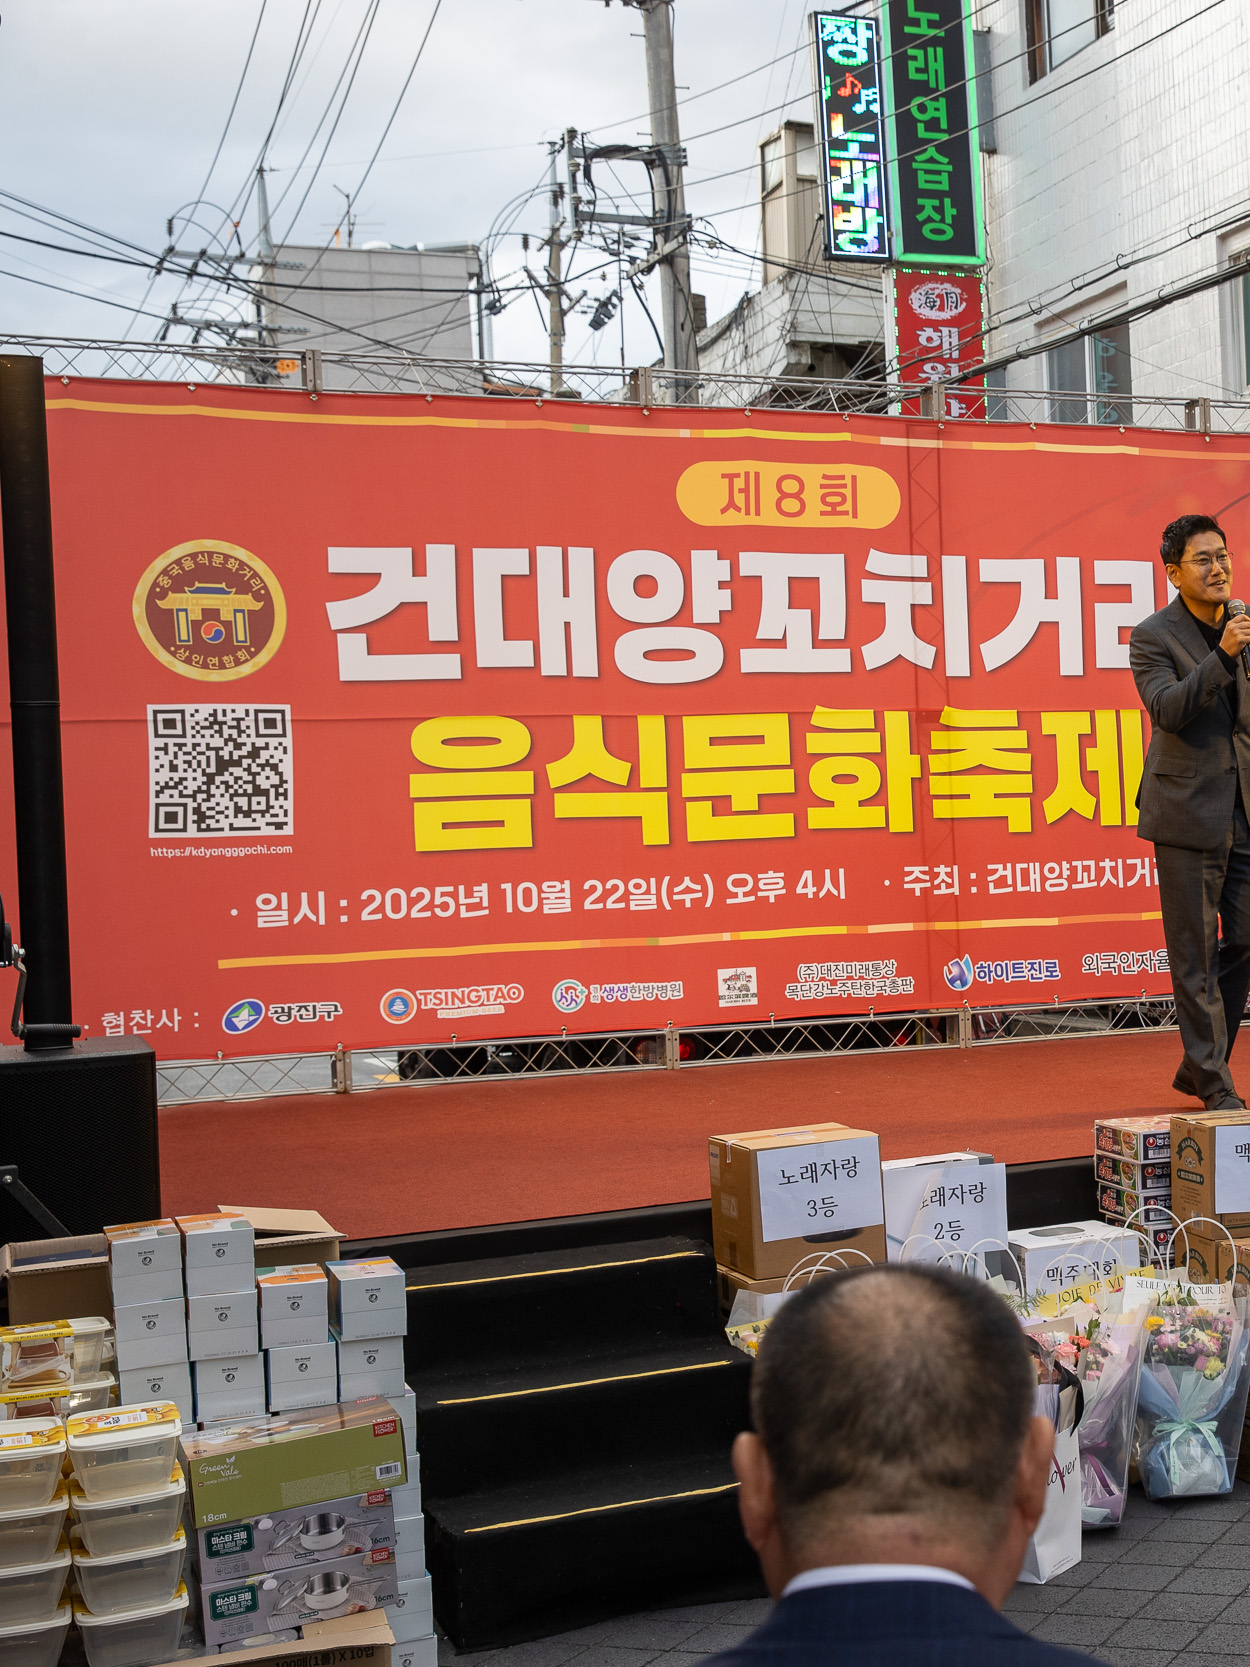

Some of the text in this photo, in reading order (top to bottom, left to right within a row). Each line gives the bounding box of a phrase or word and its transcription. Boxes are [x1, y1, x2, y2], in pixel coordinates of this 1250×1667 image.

[904, 0, 958, 242] 노래연습장
[830, 113, 884, 254] 노래방
[918, 289, 959, 311] 海月
[155, 552, 265, 591] 중국음식문화거리
[175, 648, 251, 670] 상인연합회
[409, 704, 1143, 853] 음식문화축제
[150, 843, 293, 858] https://kdyangggochi.com
[903, 863, 961, 897] 주최
[255, 890, 326, 929] 일시
[360, 882, 490, 922] 2025년
[500, 878, 572, 915] 10월
[583, 872, 714, 912] 22일(수)
[726, 869, 787, 905] 오후
[795, 867, 847, 900] 4시
[797, 961, 897, 981] (주)대진미래통상
[976, 959, 1061, 983] 하이트진로
[1081, 947, 1171, 975] 외국인자율
[418, 985, 522, 1008] TSINGTAO
[601, 981, 684, 1000] 생생한방병원
[786, 977, 914, 1000] 목단강노주탄한국총판
[102, 1007, 182, 1037] 협찬사
[269, 1002, 342, 1023] 광진구
[778, 1155, 861, 1186] 노래자랑
[806, 1195, 839, 1219] 3등
[934, 1219, 965, 1242] 2등
[1056, 1287, 1082, 1305] JOIE
[374, 1421, 395, 1429] KITCHEN
[375, 1427, 395, 1435] FLOWER
[199, 1463, 230, 1476] Green
[220, 1468, 240, 1477] Vale
[202, 1512, 227, 1524] 18cm
[211, 1533, 233, 1544] 마스타
[371, 1536, 390, 1545] 16cm
[215, 1595, 237, 1607] 마스타
